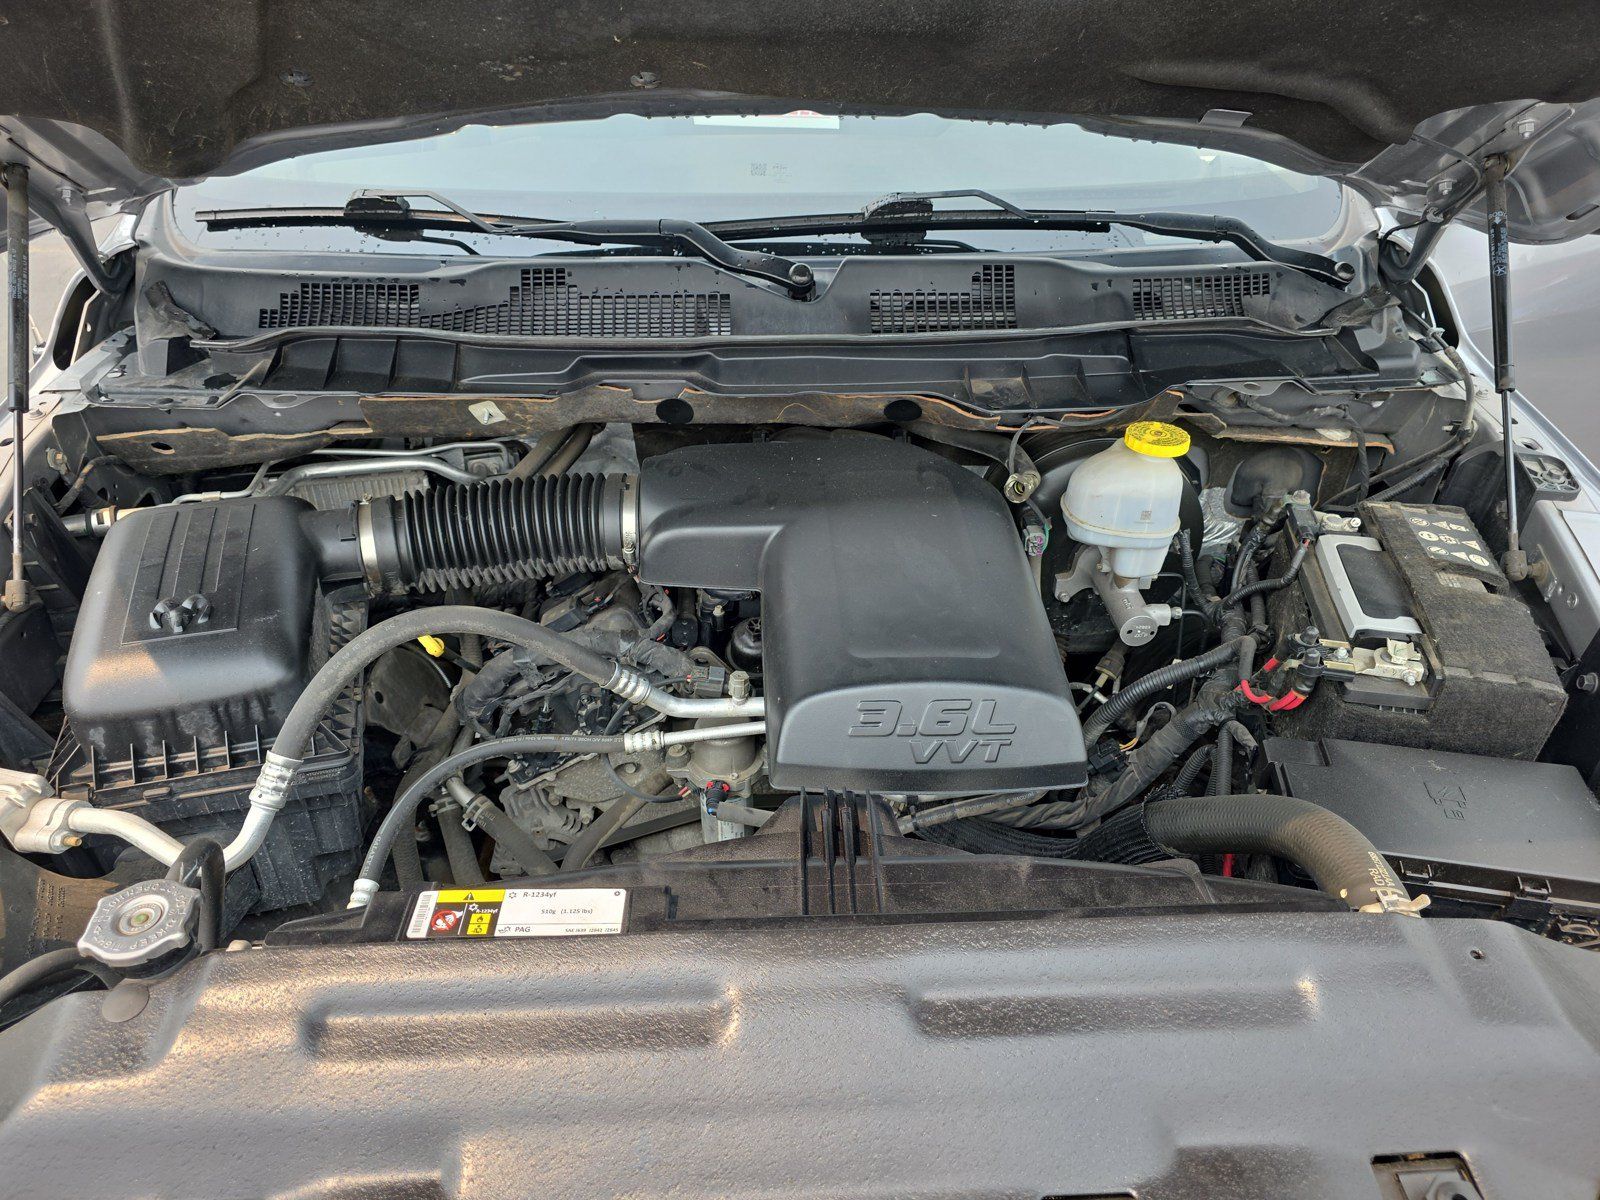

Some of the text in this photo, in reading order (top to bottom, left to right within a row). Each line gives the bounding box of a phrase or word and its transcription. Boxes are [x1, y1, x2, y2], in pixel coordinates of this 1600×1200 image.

[847, 698, 1018, 737] 3.6L
[909, 738, 1013, 764] VVT
[1368, 868, 1385, 886] RAD
[522, 891, 557, 899] R-1234yf
